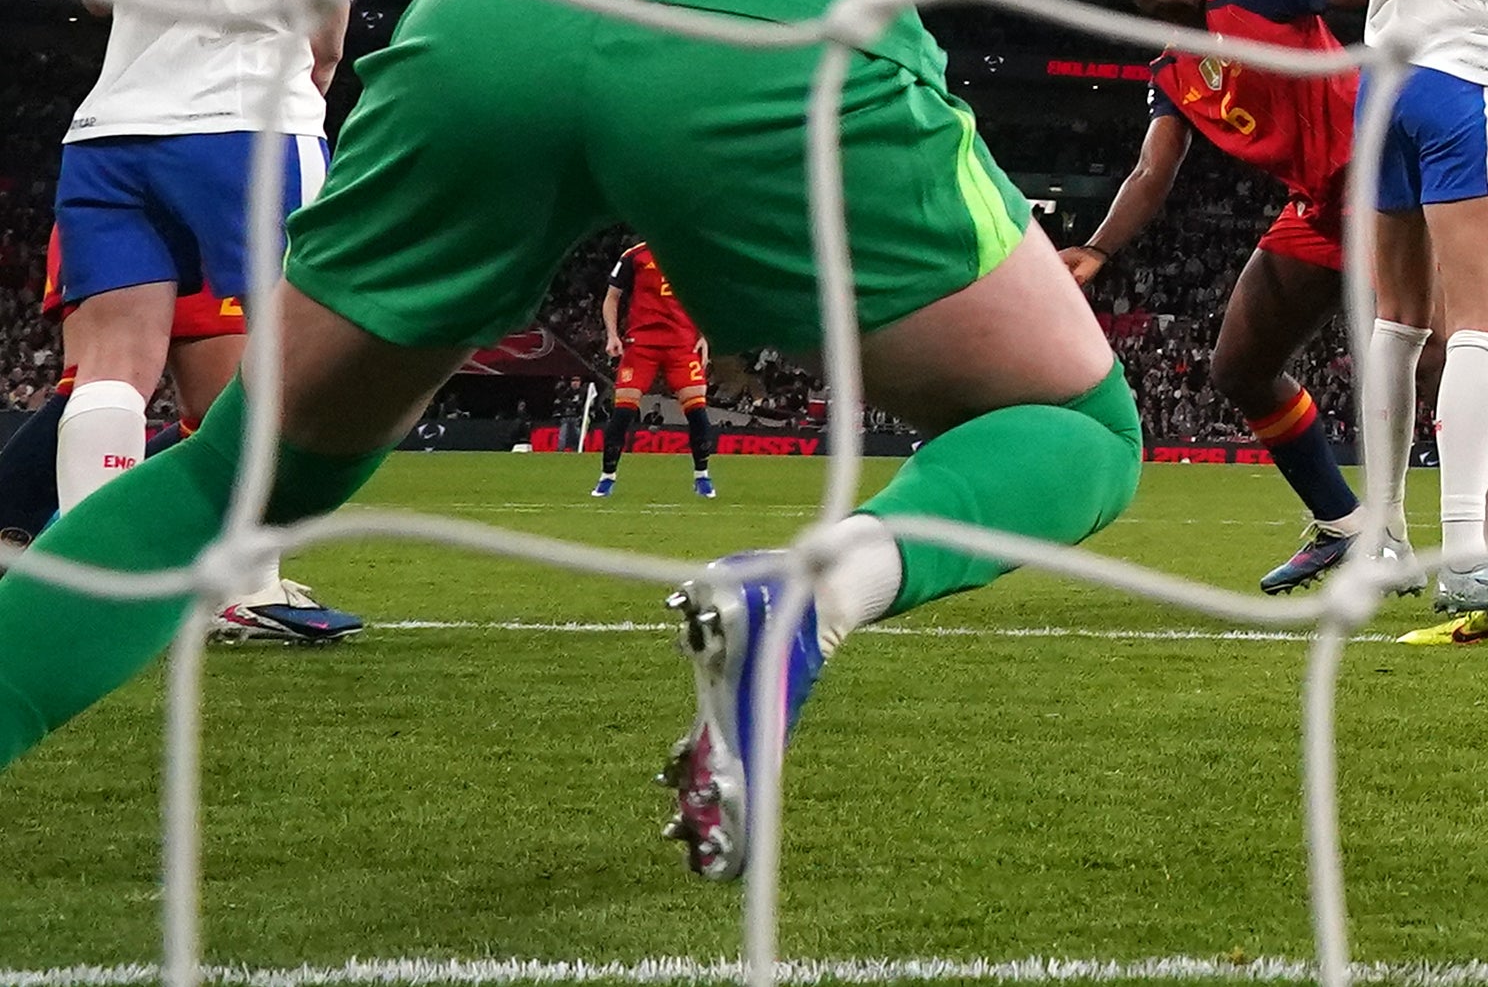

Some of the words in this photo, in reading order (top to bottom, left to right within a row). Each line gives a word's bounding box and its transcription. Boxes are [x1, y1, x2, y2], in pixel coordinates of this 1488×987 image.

[1220, 91, 1257, 135] 6
[689, 361, 704, 381] 2
[633, 430, 692, 453] 202
